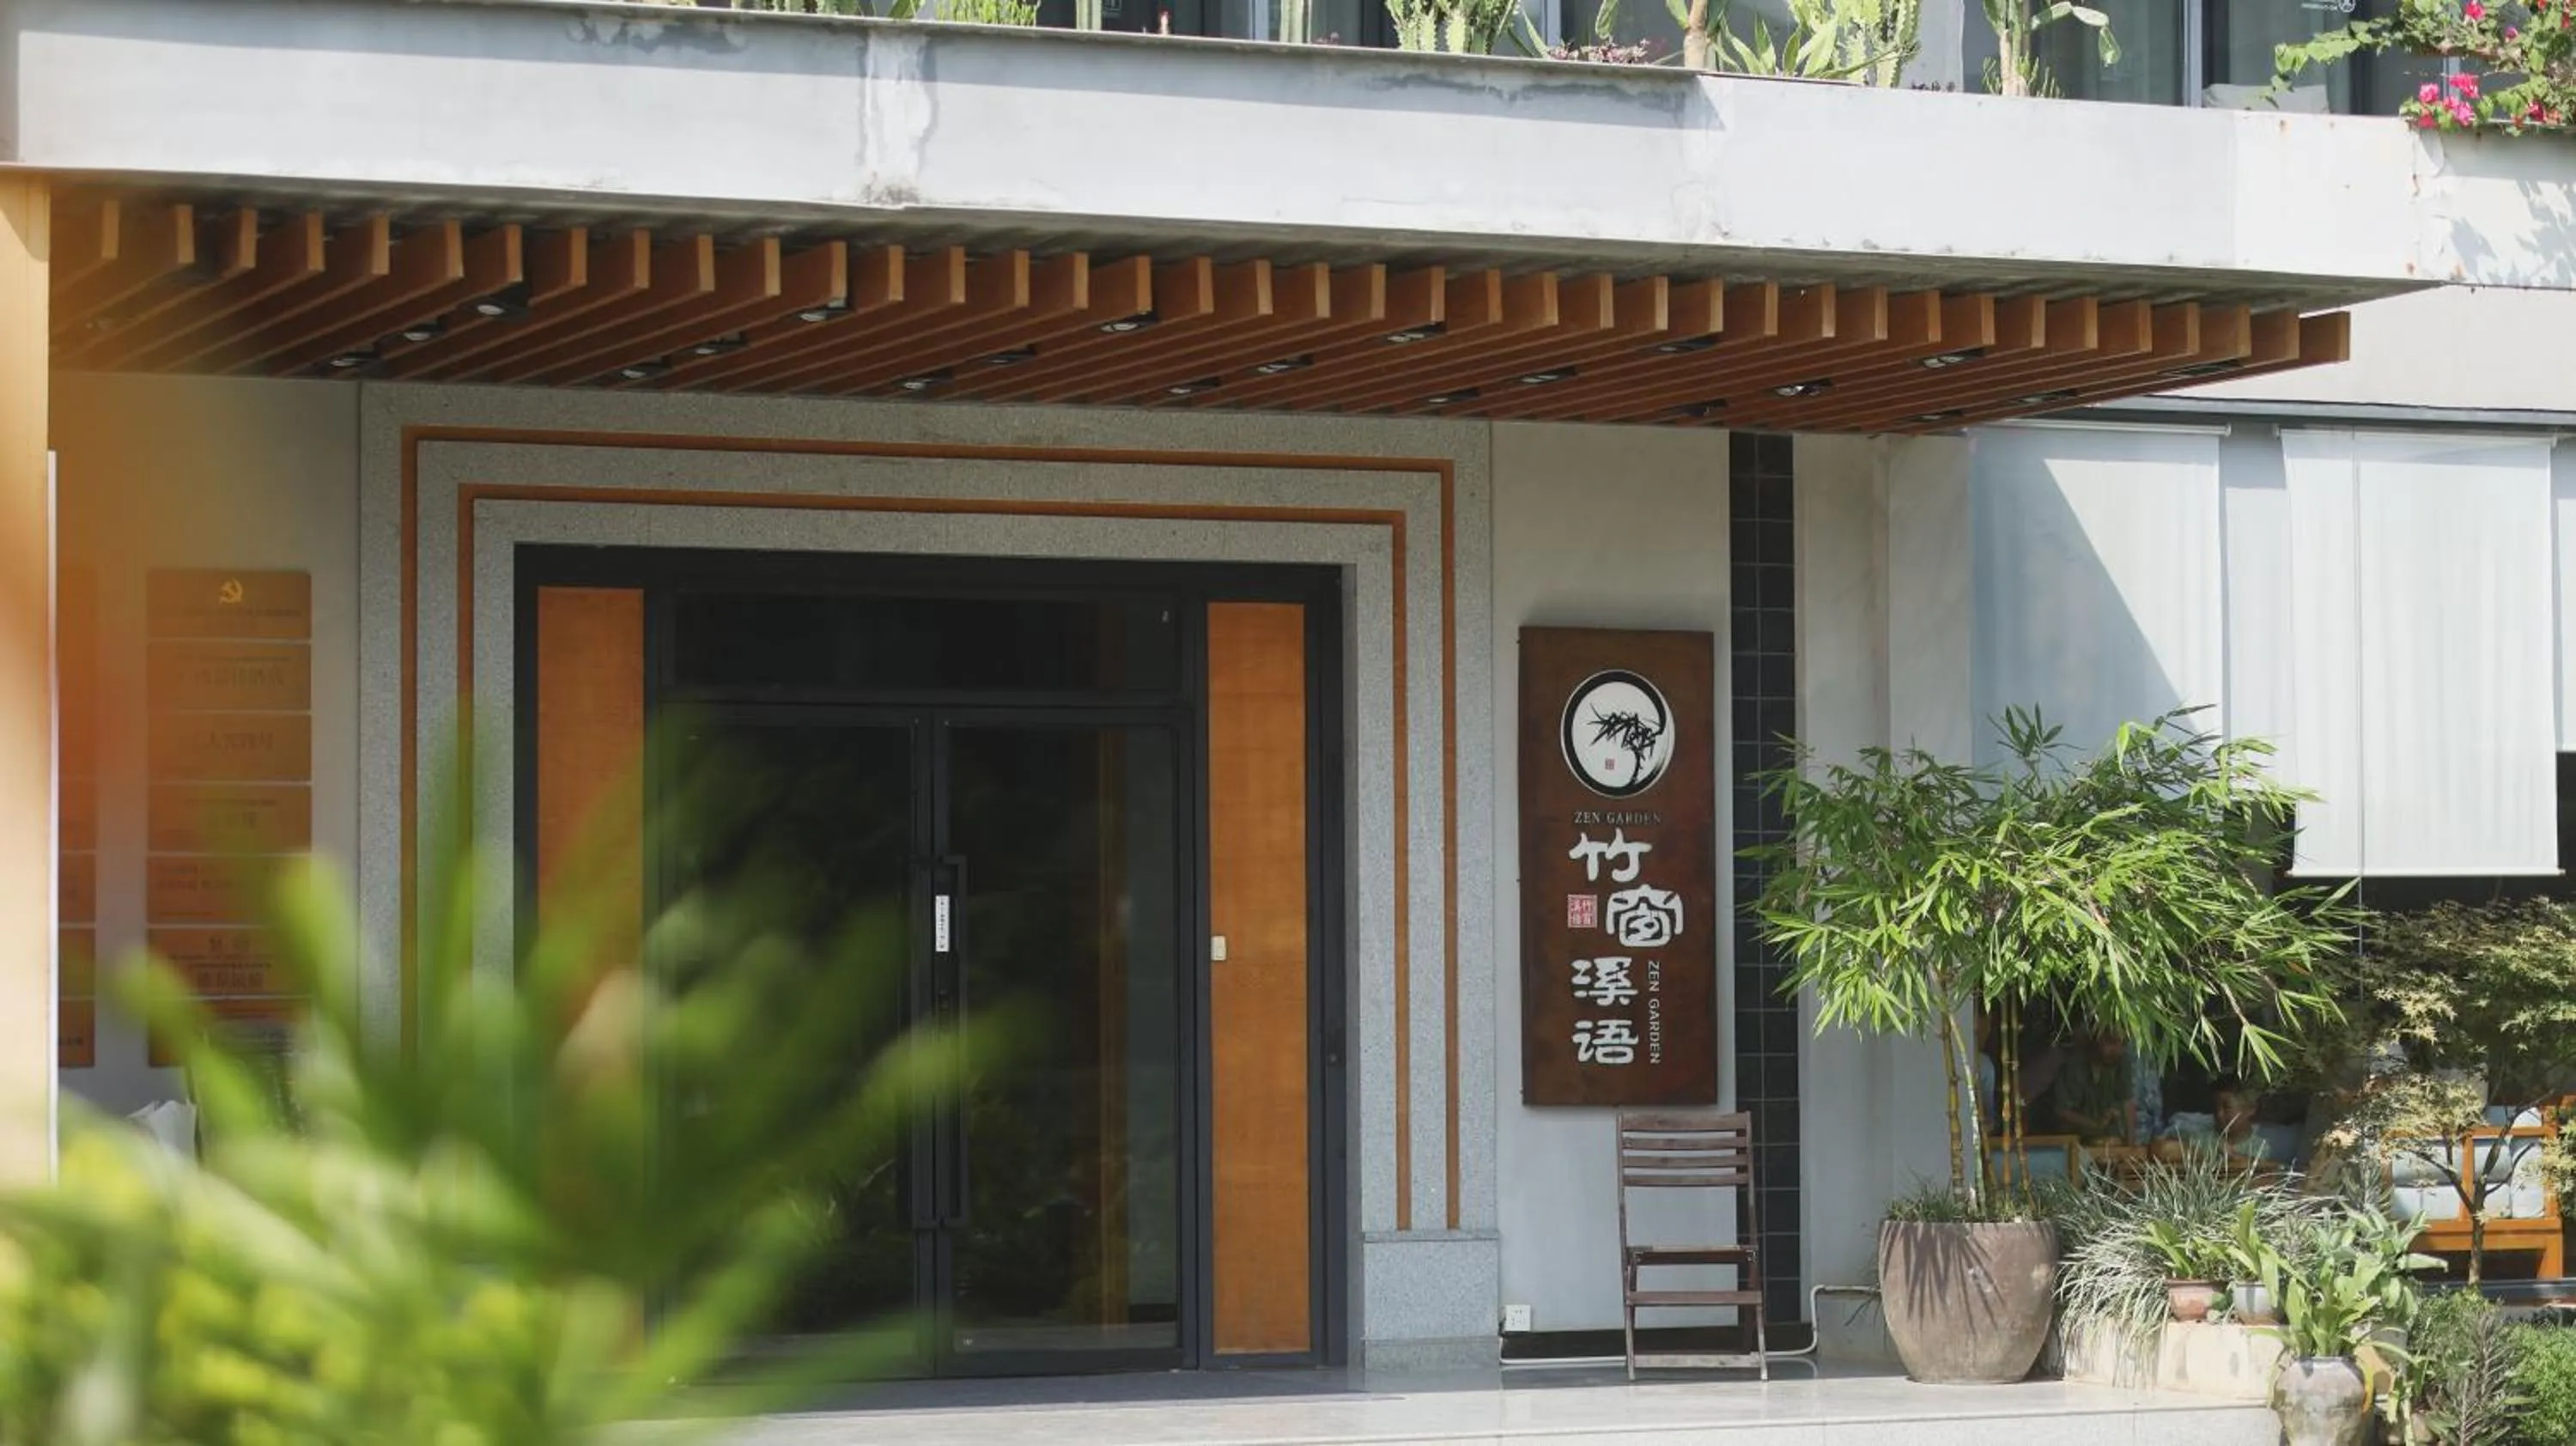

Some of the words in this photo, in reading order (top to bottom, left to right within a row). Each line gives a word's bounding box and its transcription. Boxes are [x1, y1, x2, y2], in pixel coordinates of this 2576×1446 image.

[1573, 811, 1601, 824] ZEN
[1607, 811, 1662, 825] GARDEN
[1648, 960, 1660, 992] ZEN
[1648, 998, 1661, 1065] GARDEN
